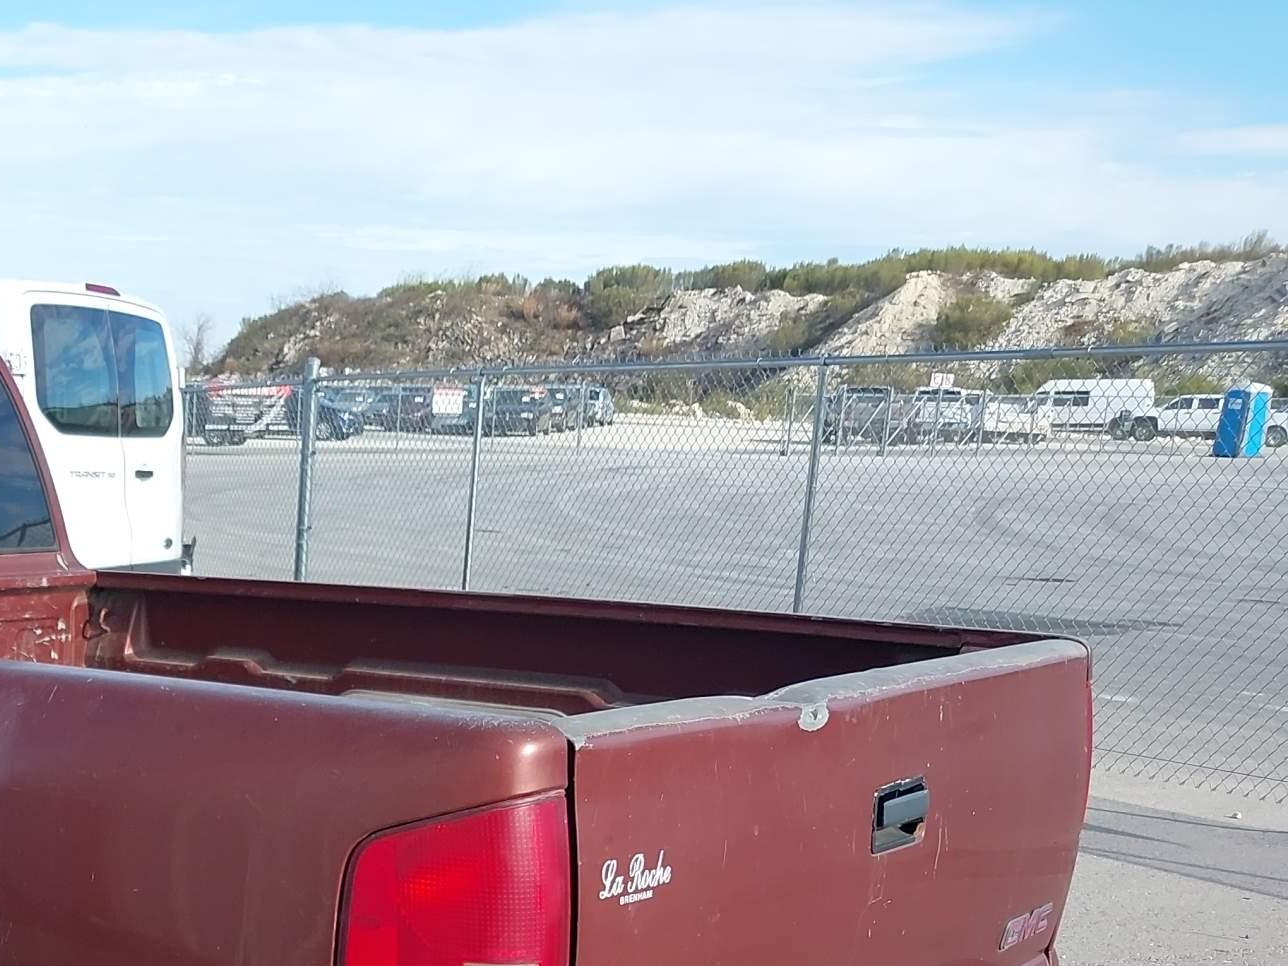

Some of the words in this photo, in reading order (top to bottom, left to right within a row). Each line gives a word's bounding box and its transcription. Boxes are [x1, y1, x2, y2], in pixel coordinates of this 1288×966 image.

[599, 859, 624, 899] La
[627, 850, 672, 893] Roche
[619, 890, 653, 905] BRENHAM
[999, 902, 1053, 952] GMC
